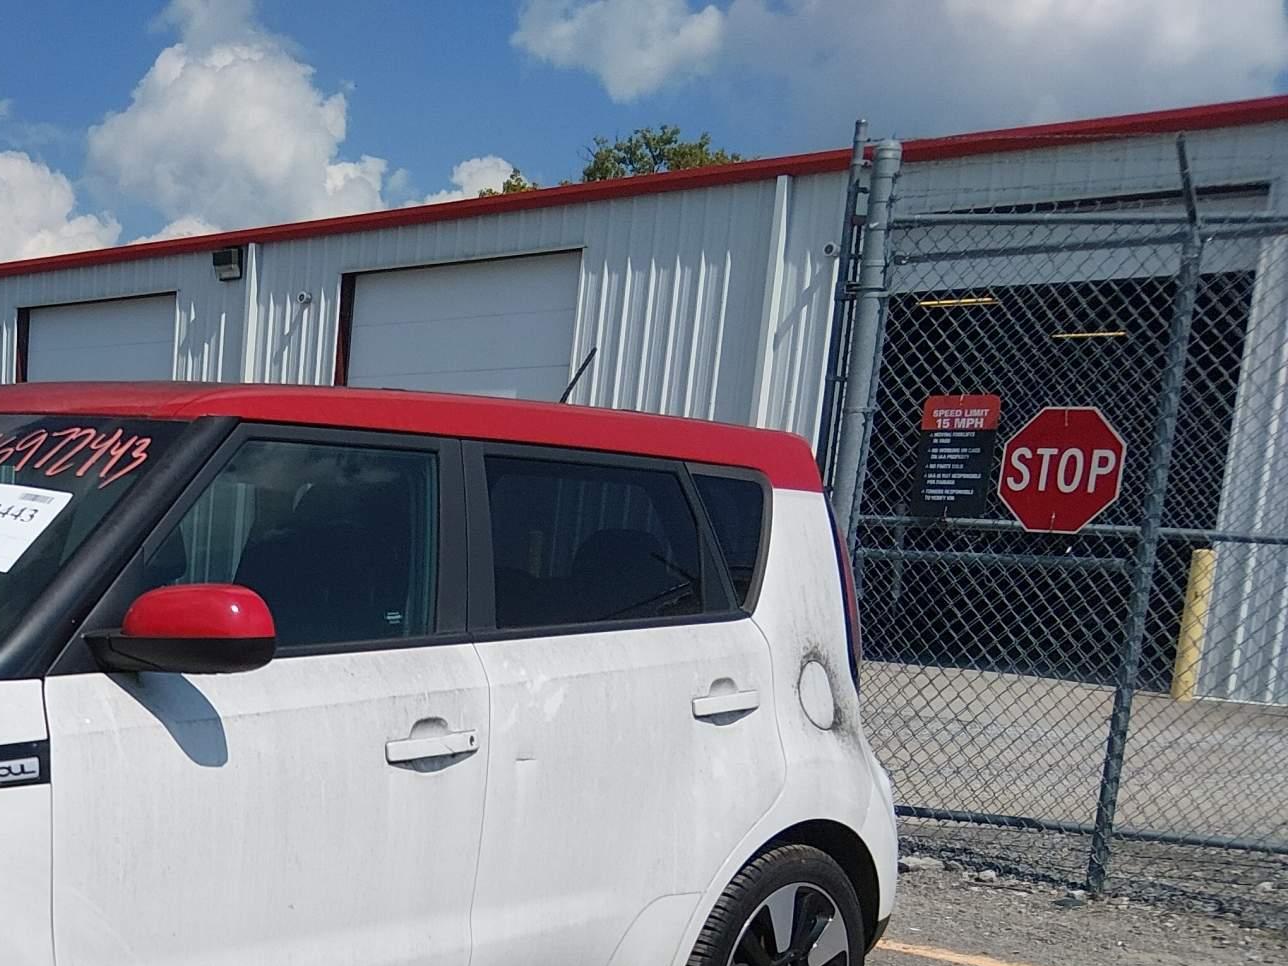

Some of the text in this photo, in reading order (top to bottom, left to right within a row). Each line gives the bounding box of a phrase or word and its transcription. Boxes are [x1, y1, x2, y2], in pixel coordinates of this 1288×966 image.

[932, 408, 990, 418] SPEED LIMIT
[935, 417, 985, 429] 15 MPH
[1006, 446, 1117, 494] STOP
